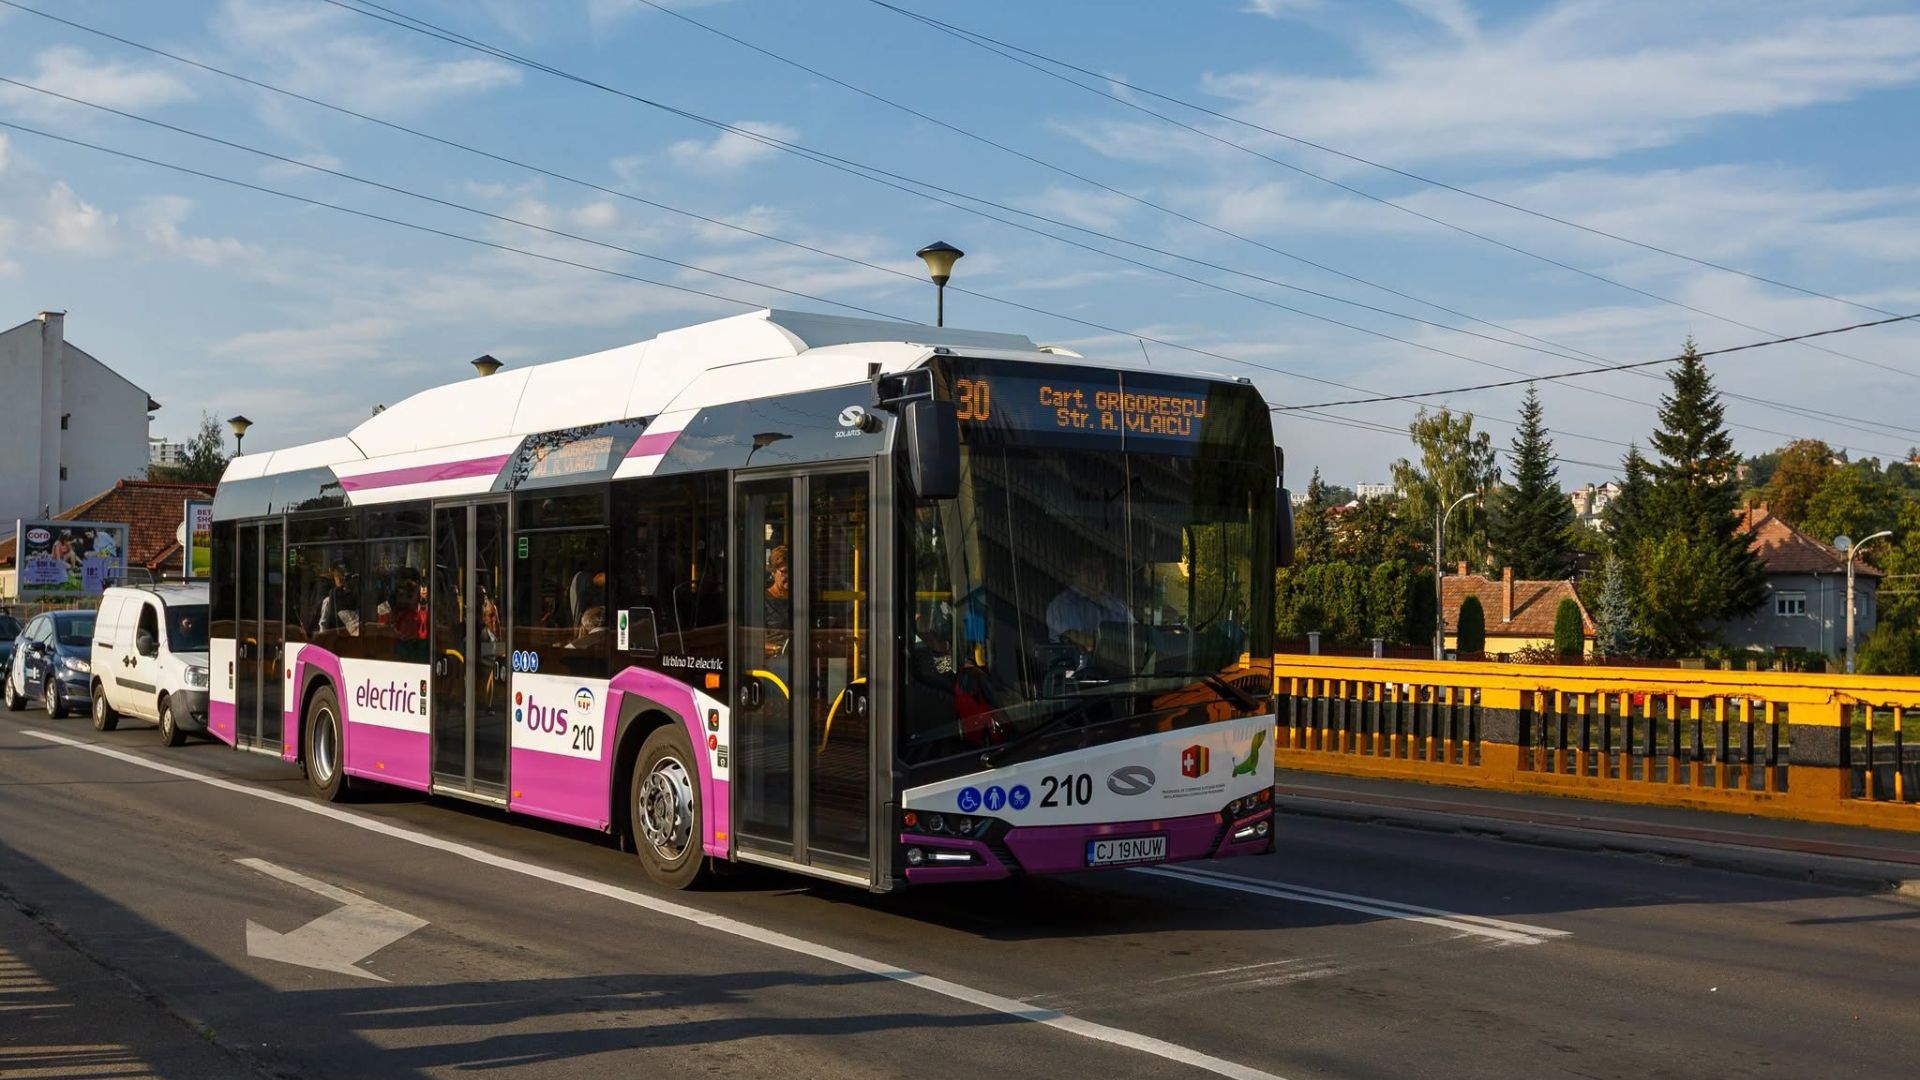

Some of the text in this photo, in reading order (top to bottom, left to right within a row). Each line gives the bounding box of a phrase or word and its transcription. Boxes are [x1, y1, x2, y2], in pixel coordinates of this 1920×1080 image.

[957, 379, 990, 421] 30
[1040, 386, 1206, 418] Cart. GRIGORESCU
[1056, 408, 1094, 429] Str.
[1125, 413, 1192, 436] VLAICU
[662, 655, 724, 670] Urbino 12 electric
[356, 678, 416, 714] electric
[527, 694, 568, 736] bus
[572, 724, 595, 752] 210
[1040, 773, 1093, 808] 210
[1096, 838, 1163, 860] CJ 19 NUW
